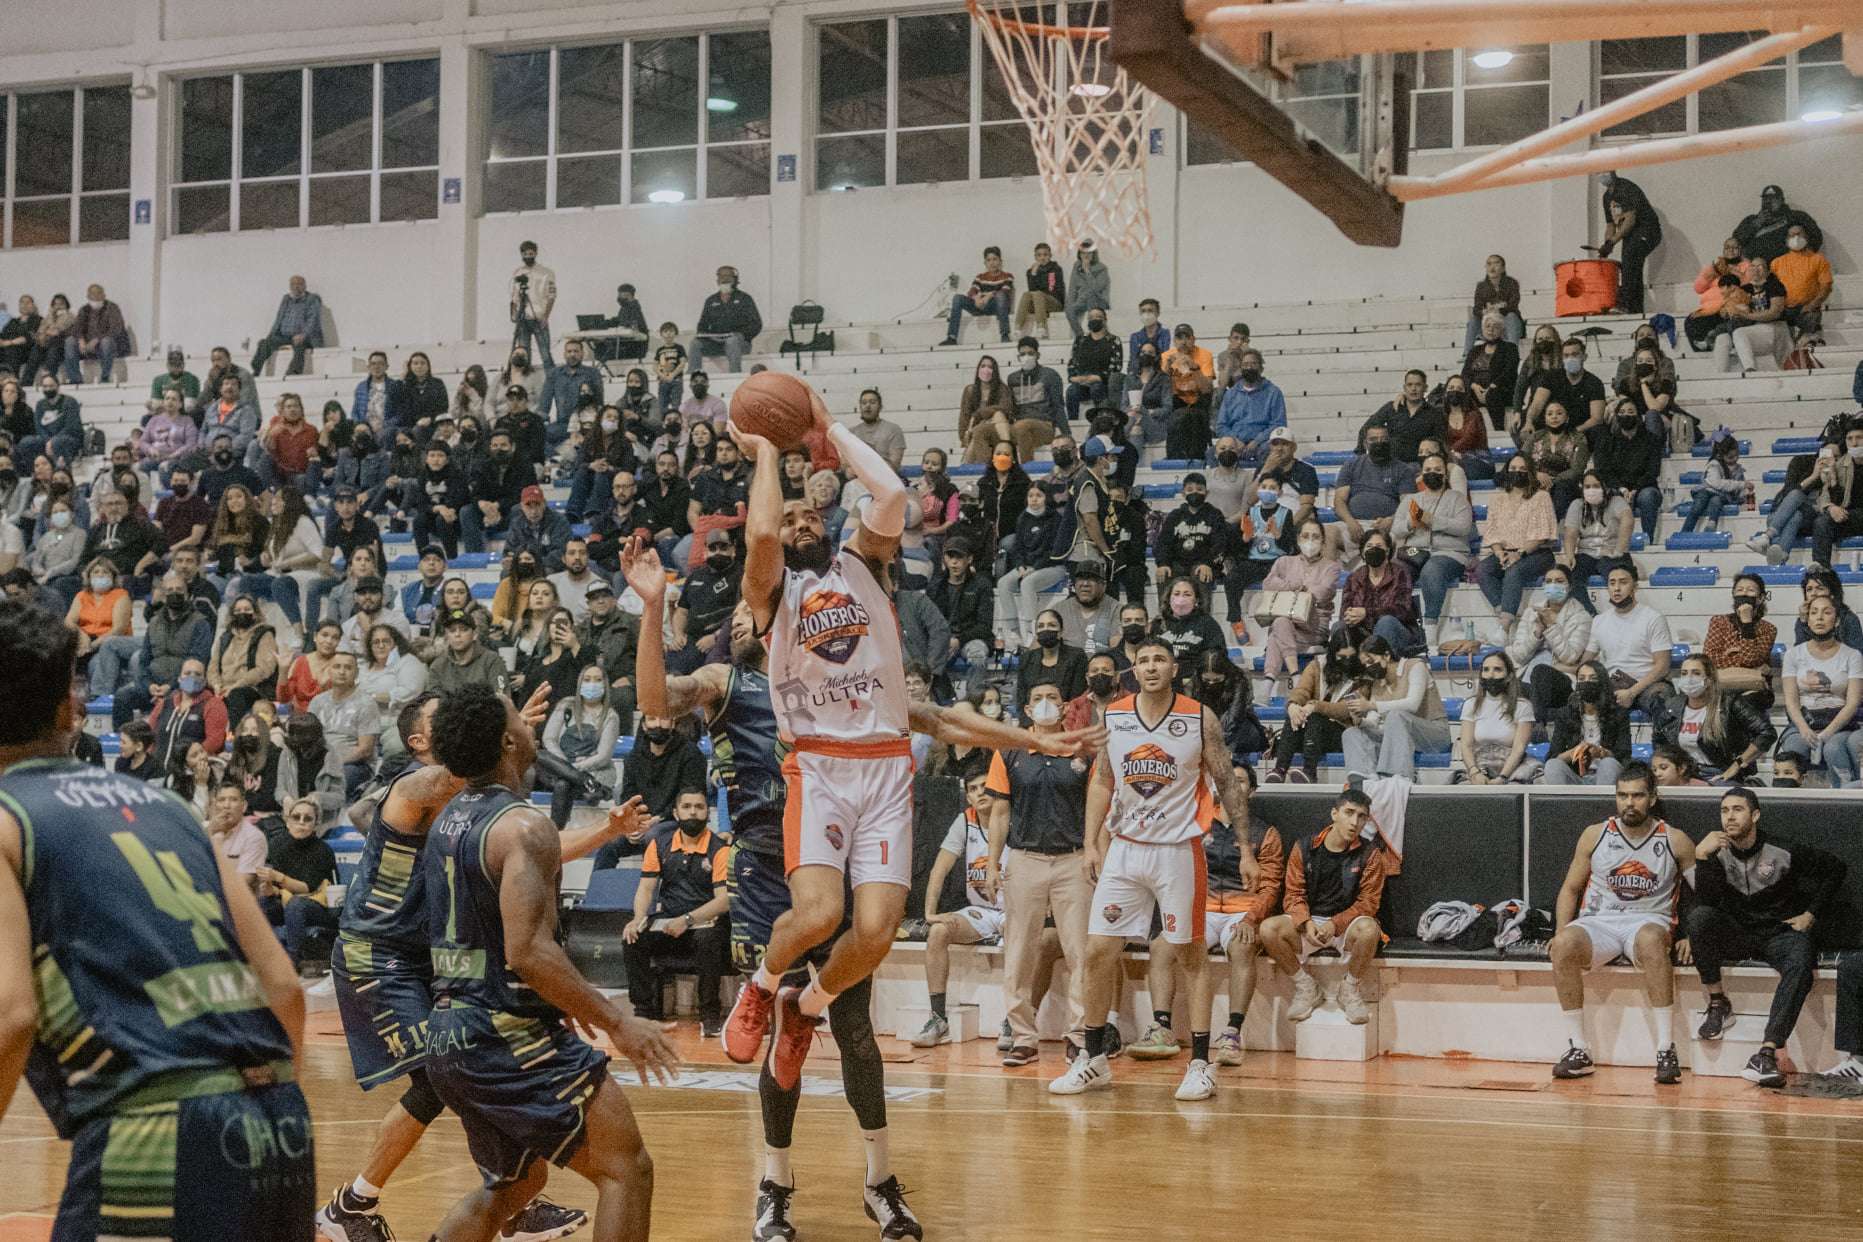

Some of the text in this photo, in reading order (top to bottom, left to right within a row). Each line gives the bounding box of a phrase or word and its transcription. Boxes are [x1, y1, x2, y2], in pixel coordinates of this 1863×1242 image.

[1693, 554, 1700, 564] 4
[1591, 591, 1597, 602] 5
[1676, 591, 1683, 602] 4
[812, 677, 884, 707] ULTRA
[1287, 677, 1294, 690] 8
[1466, 678, 1473, 690] 6
[1122, 760, 1177, 780] PIONEROS
[880, 840, 889, 865] 1
[110, 831, 223, 953] 4
[1607, 874, 1661, 893] PIONEROS
[444, 855, 457, 943] 1
